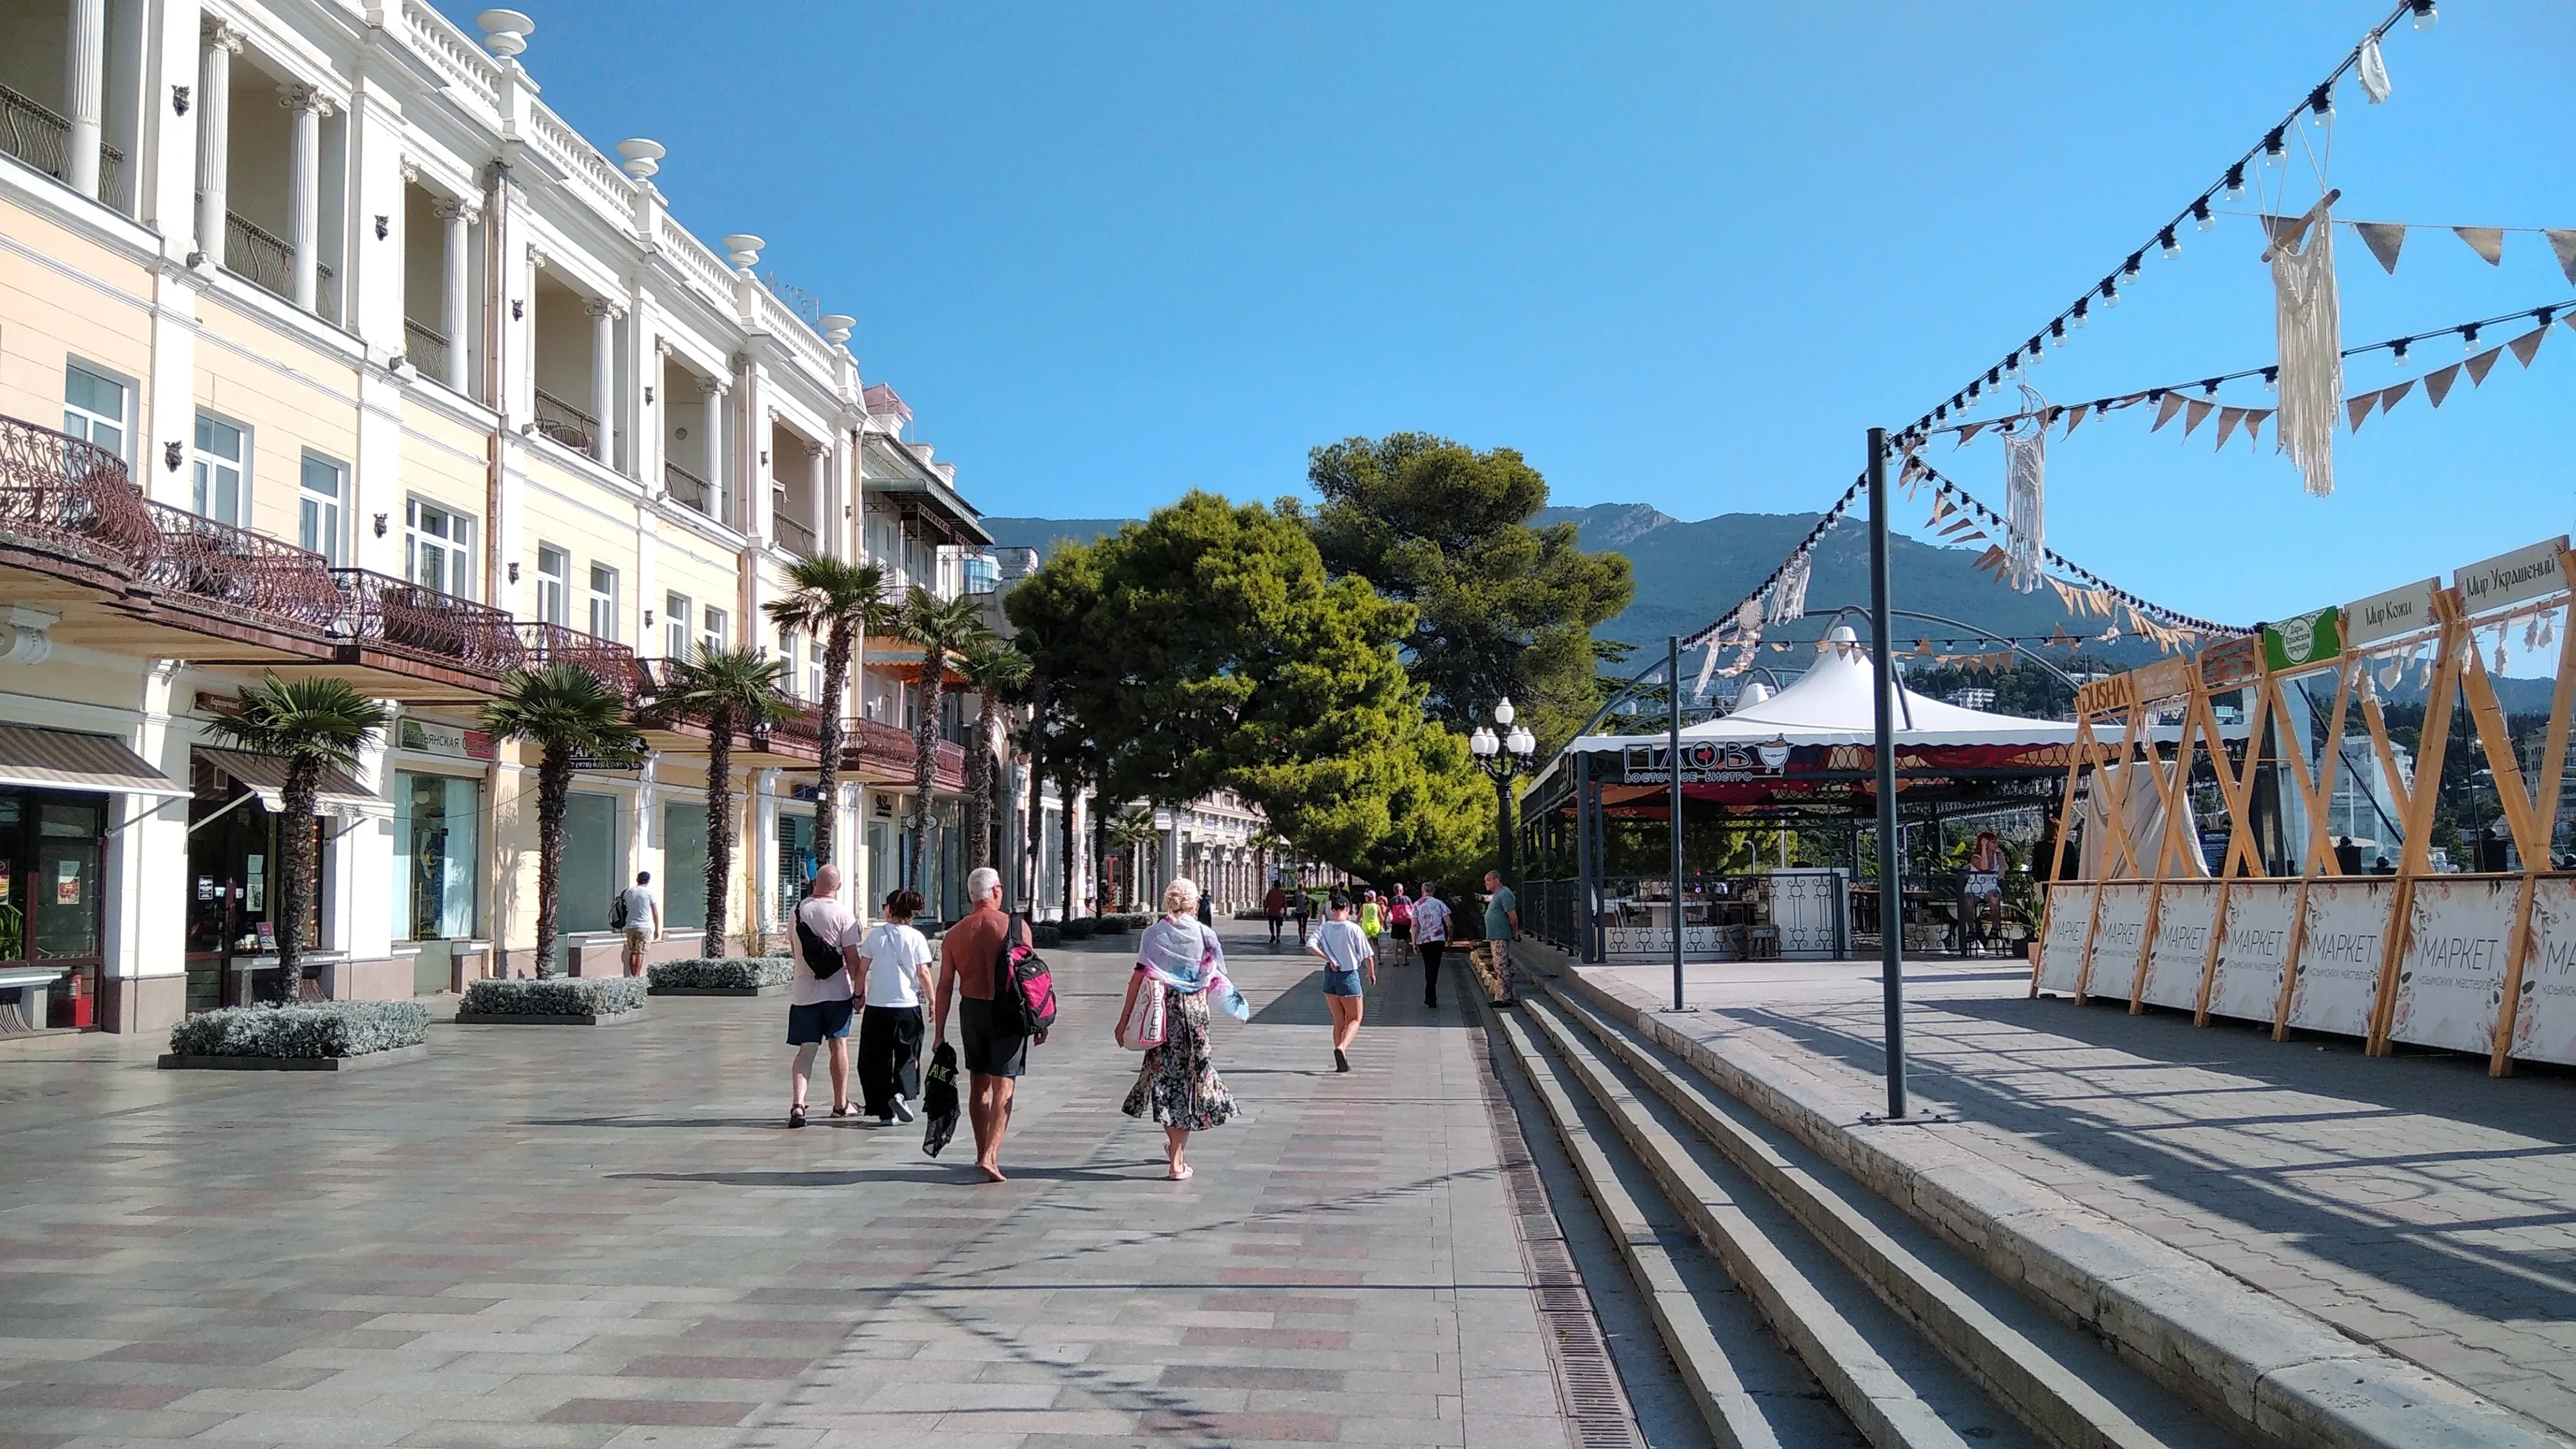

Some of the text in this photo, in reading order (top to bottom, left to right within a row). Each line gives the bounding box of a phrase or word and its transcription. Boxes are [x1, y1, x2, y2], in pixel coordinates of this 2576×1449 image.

[2466, 554, 2555, 598] Мир Украшений
[2366, 601, 2412, 627] Мир Кожи
[1624, 772, 1753, 783] ВОСТОЧОЕ БИСТРО
[2101, 923, 2142, 945] МАРКЕТ
[2160, 925, 2207, 950] МАРКЕТ
[2230, 929, 2284, 956] МАРКЕТ
[2311, 933, 2377, 963] МАРКЕТ
[2420, 936, 2499, 971] МАРКЕТ
